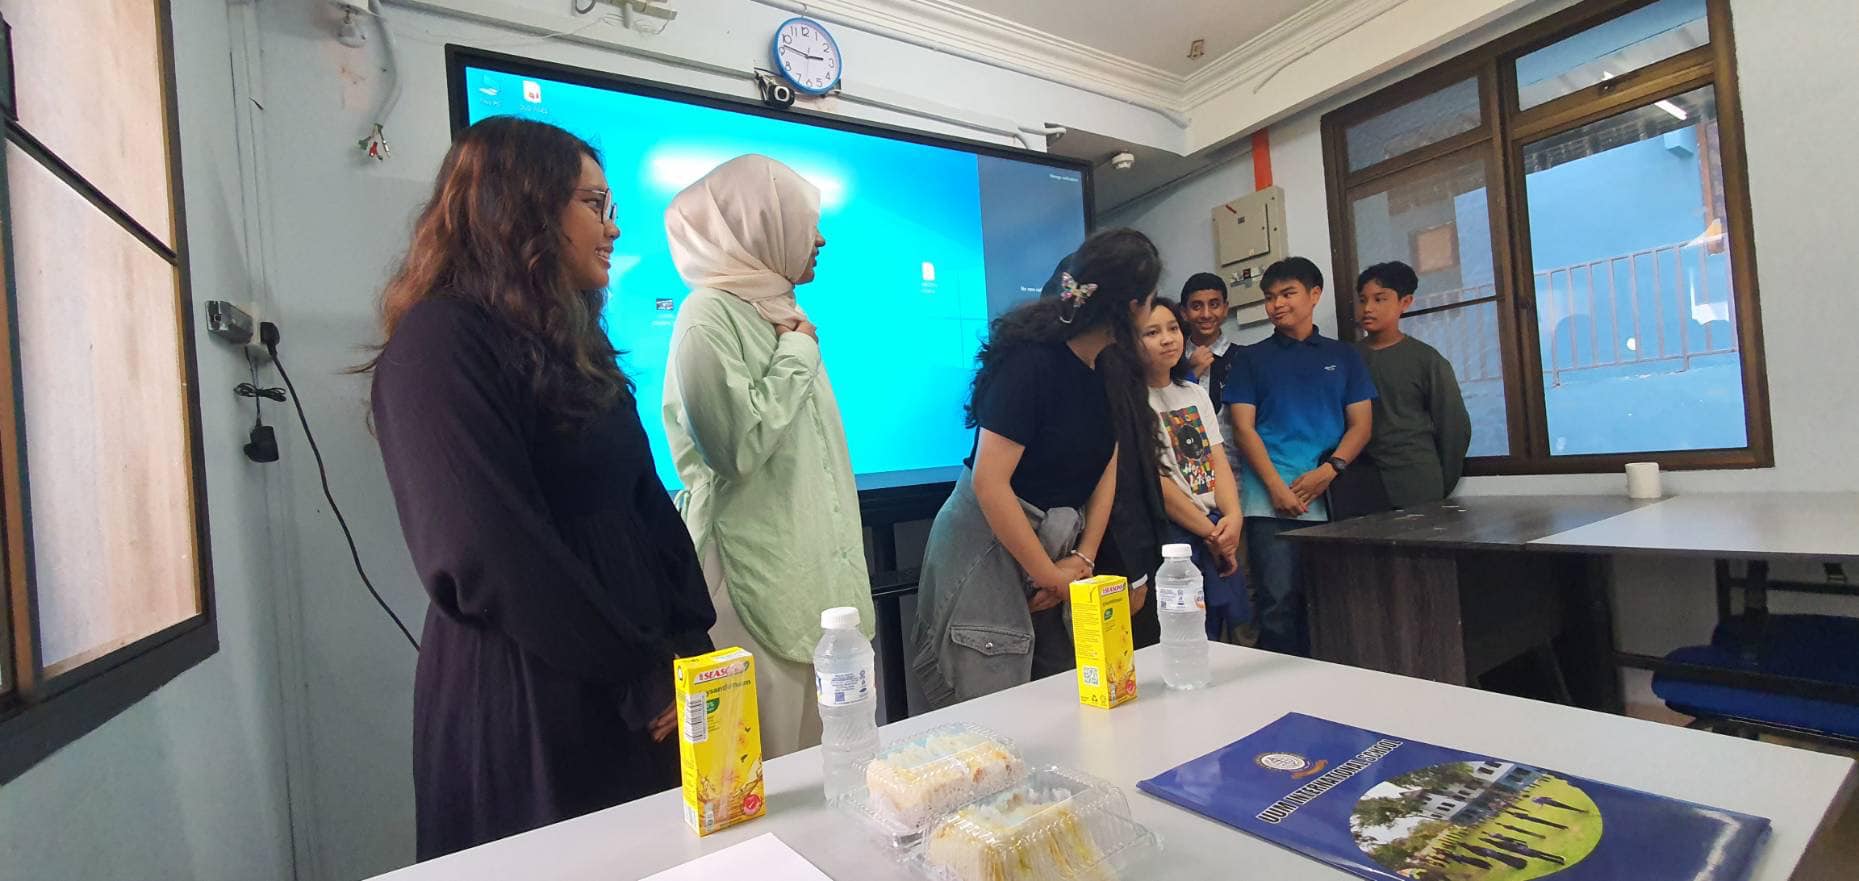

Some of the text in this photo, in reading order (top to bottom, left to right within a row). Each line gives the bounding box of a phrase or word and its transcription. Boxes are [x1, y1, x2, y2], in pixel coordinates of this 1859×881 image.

[801, 26, 810, 37] 12
[782, 34, 792, 45] 10
[822, 42, 830, 53] 2
[785, 61, 792, 71] 8
[1256, 800, 1299, 823] UUM
[1283, 759, 1372, 805] INTERNATIONAL
[1355, 738, 1403, 762] SCHOOL
